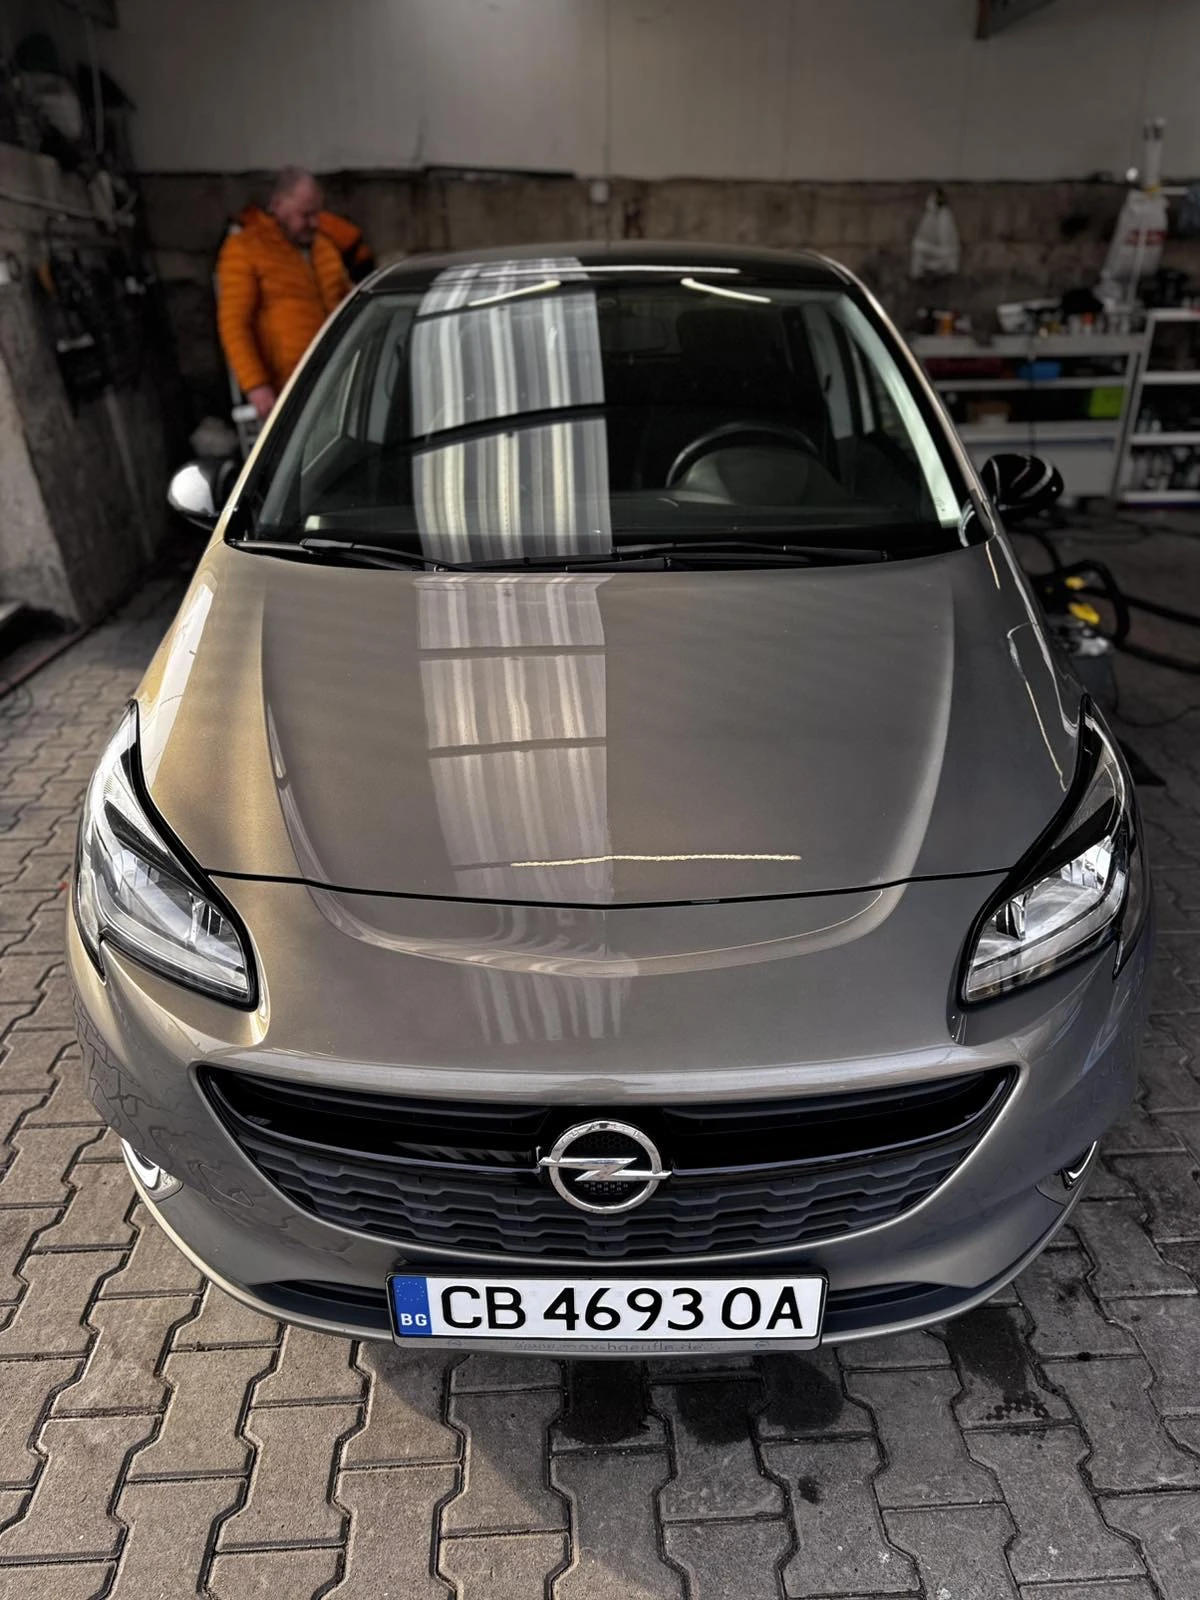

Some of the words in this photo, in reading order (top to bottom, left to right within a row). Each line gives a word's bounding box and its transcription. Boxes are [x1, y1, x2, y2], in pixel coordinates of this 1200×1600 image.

[400, 1313, 428, 1327] BG
[441, 1285, 525, 1330] CB
[543, 1287, 704, 1331] 4693
[721, 1286, 803, 1331] OA
